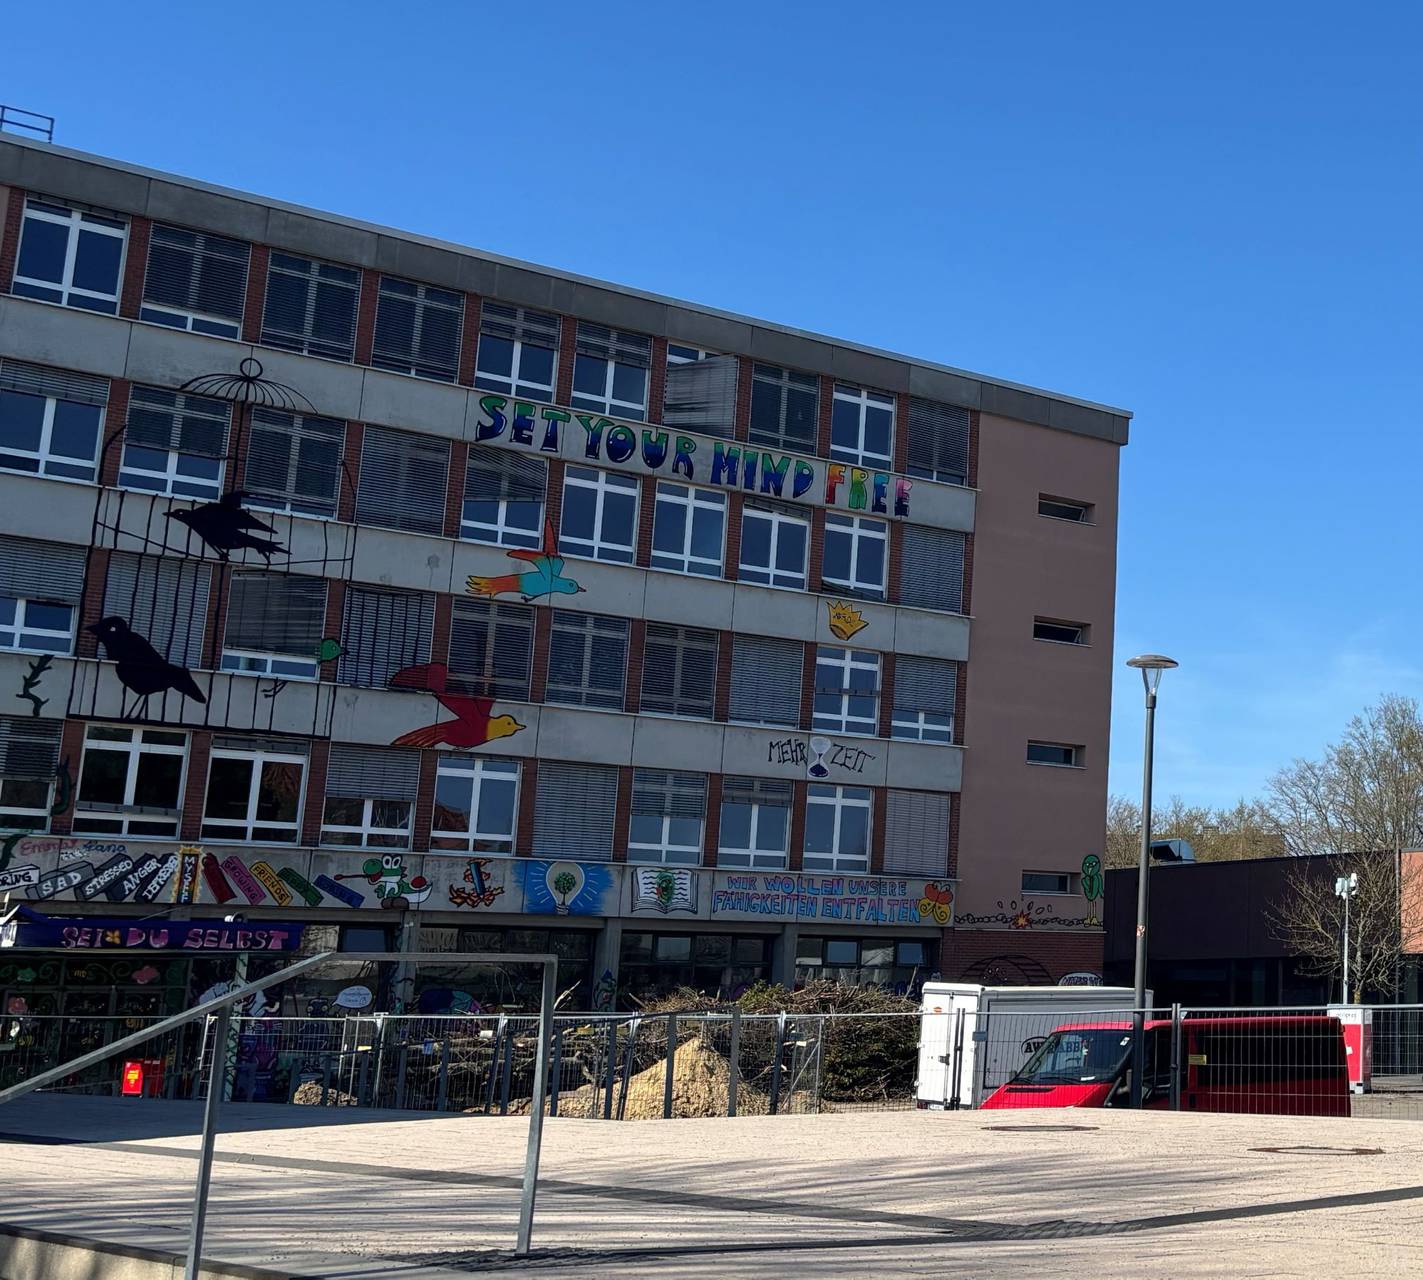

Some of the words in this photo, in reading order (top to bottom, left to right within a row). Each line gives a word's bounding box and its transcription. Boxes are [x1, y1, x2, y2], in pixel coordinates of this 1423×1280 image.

[475, 395, 571, 453] SET
[574, 414, 696, 480] YOUR
[710, 442, 814, 498] MIND
[825, 463, 913, 517] FREE
[767, 738, 808, 766] MEHR
[830, 743, 874, 773] ZEIT
[42, 871, 82, 896] SAD
[85, 859, 133, 895] STRESSED
[122, 857, 162, 895] ANGER
[181, 856, 195, 903] MYSELF
[252, 864, 285, 902] FRIENDS
[727, 876, 757, 891] WIR
[764, 876, 844, 895] WOLLEN
[849, 880, 907, 896] UNSERE
[712, 890, 818, 917] FÄHIGKEITEN
[821, 897, 921, 923] ENTFALTEN
[61, 928, 103, 949] SEI
[126, 928, 169, 948] DU
[183, 928, 289, 950] SELBST
